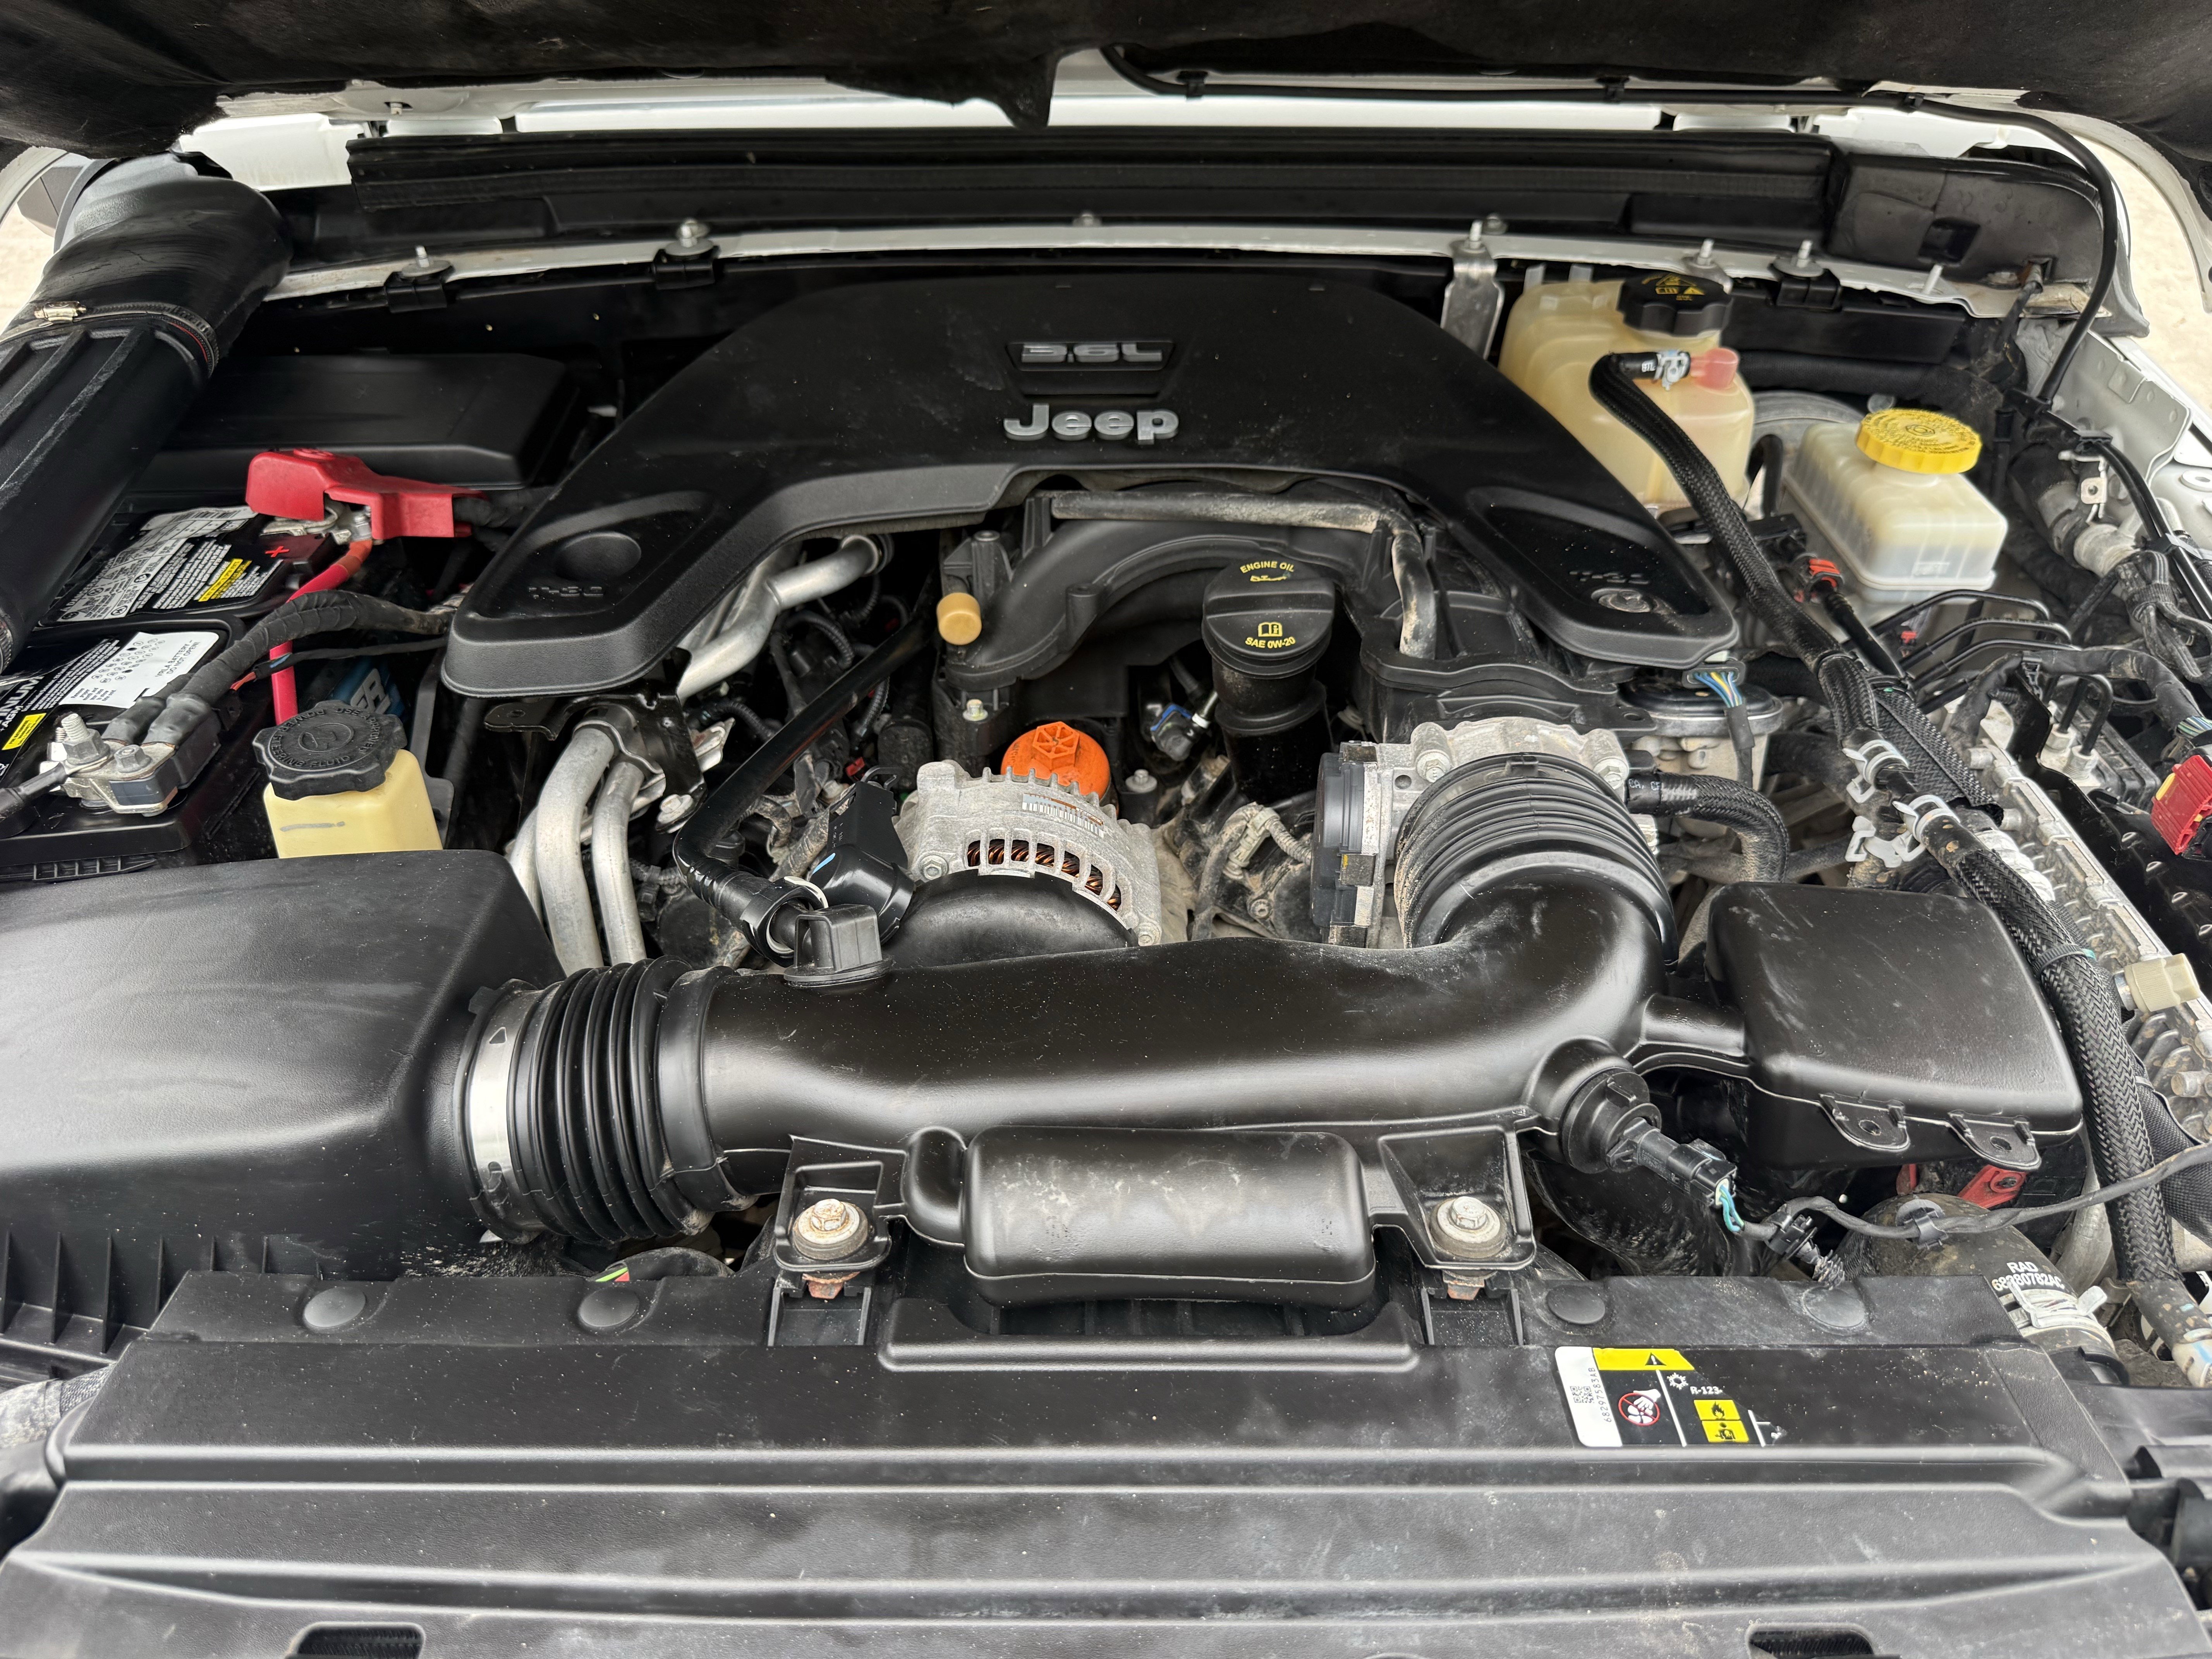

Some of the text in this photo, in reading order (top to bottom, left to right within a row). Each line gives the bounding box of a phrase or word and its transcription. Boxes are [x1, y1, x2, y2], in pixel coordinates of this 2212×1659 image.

[1003, 403, 1179, 445] Jeep
[1240, 561, 1295, 574] ENGINE OIL
[1245, 636, 1296, 649] SAE 0W-20
[154, 664, 172, 677] VRLA
[168, 644, 190, 666] BATTERY
[173, 656, 185, 667] NOT
[0, 676, 45, 725] INUM
[2, 706, 24, 728] AGM
[271, 708, 351, 768] POWER STEERING FLUID
[360, 714, 381, 754] APPROVED
[2006, 1261, 2039, 1273] RAD
[1588, 1367, 1612, 1422] 68297583AB
[1690, 1386, 1723, 1395] R-123
